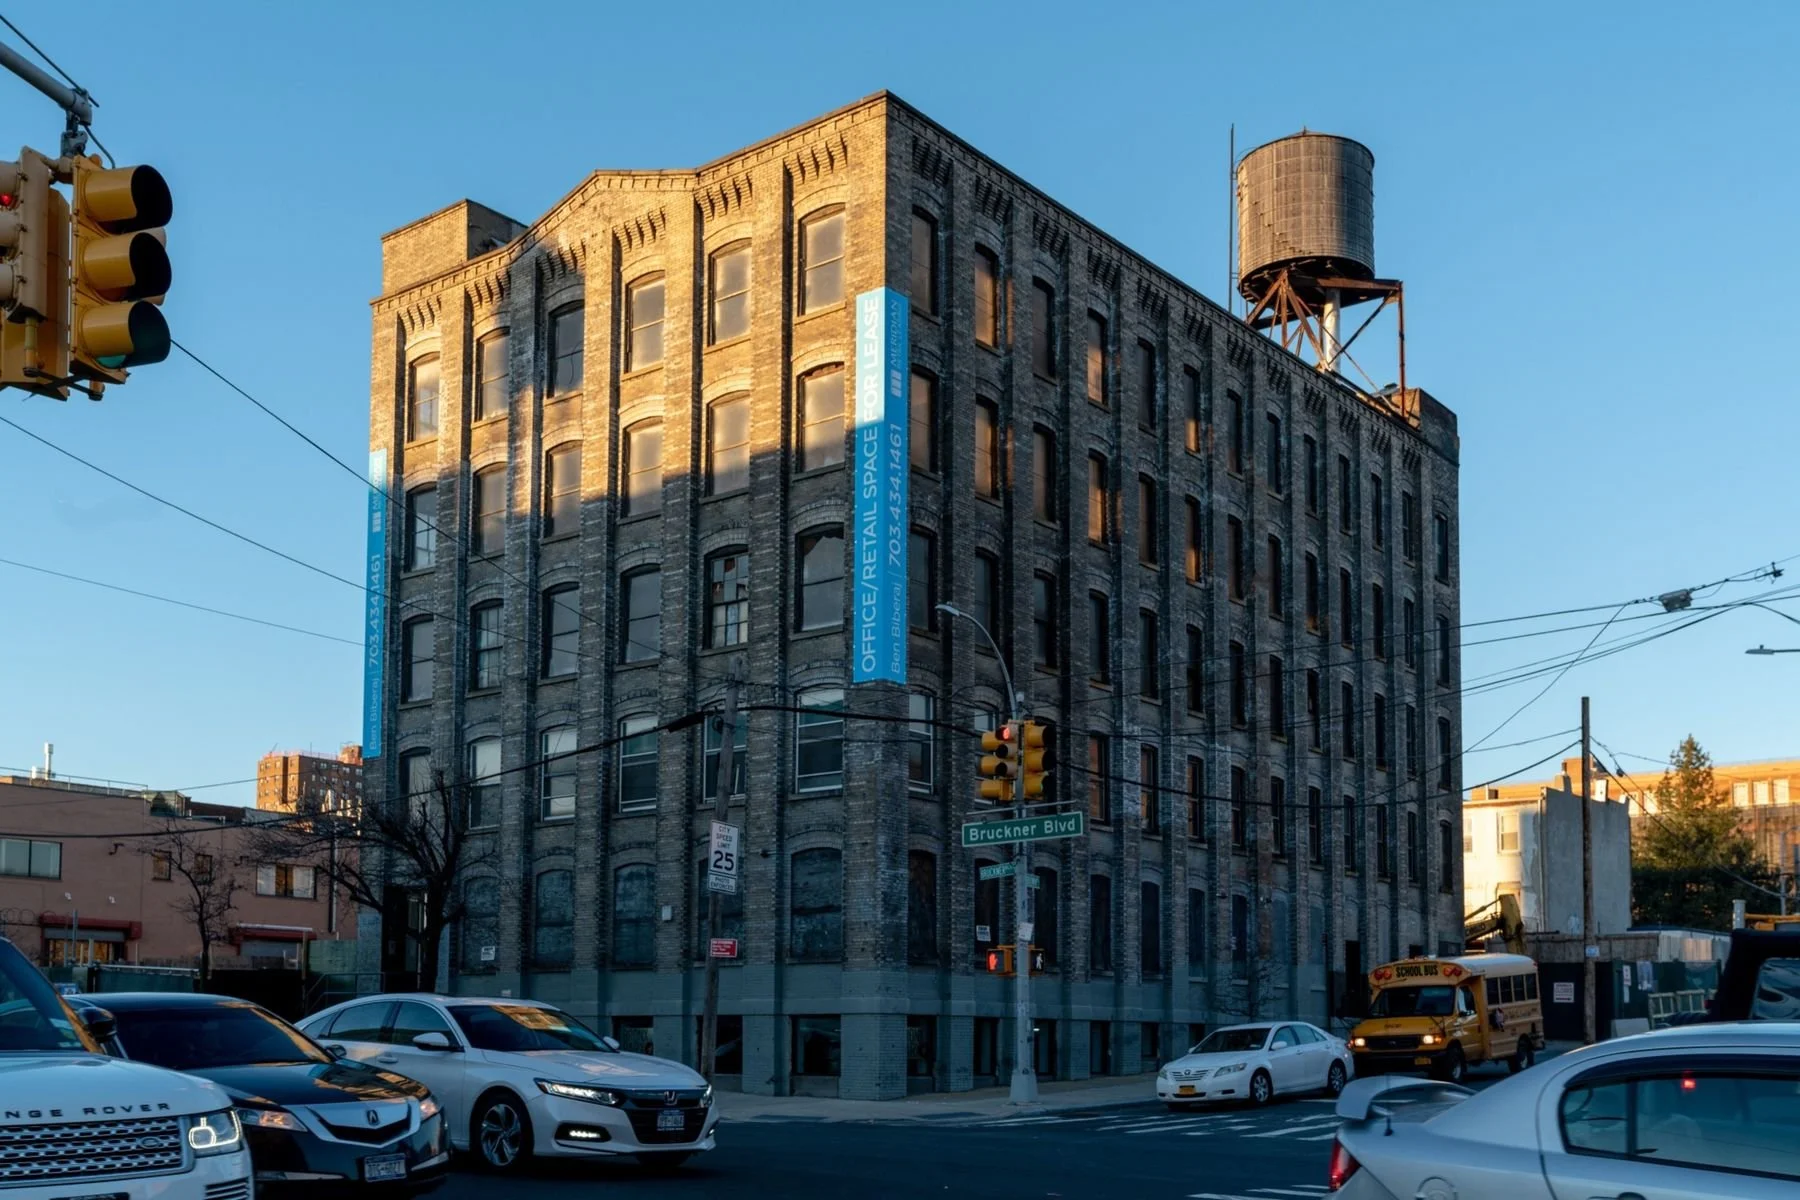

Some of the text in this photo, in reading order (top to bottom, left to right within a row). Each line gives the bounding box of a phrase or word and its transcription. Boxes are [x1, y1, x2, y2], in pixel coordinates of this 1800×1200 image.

[890, 300, 898, 367] MERIDIAN
[862, 297, 879, 672] OFFICE/RETAIL SPACE FOR LEASE
[889, 426, 902, 568] 703.434.1461
[369, 554, 381, 668] 703.4341461
[891, 642, 901, 674] Ben
[716, 833, 733, 842] SPEED
[718, 825, 731, 833] CITY
[969, 817, 1076, 841] Bruckner Blvd
[717, 841, 731, 849] LIMIT
[713, 850, 734, 871] 25
[1396, 965, 1438, 978] SCHOOL BUS
[83, 1102, 171, 1115] ROVER
